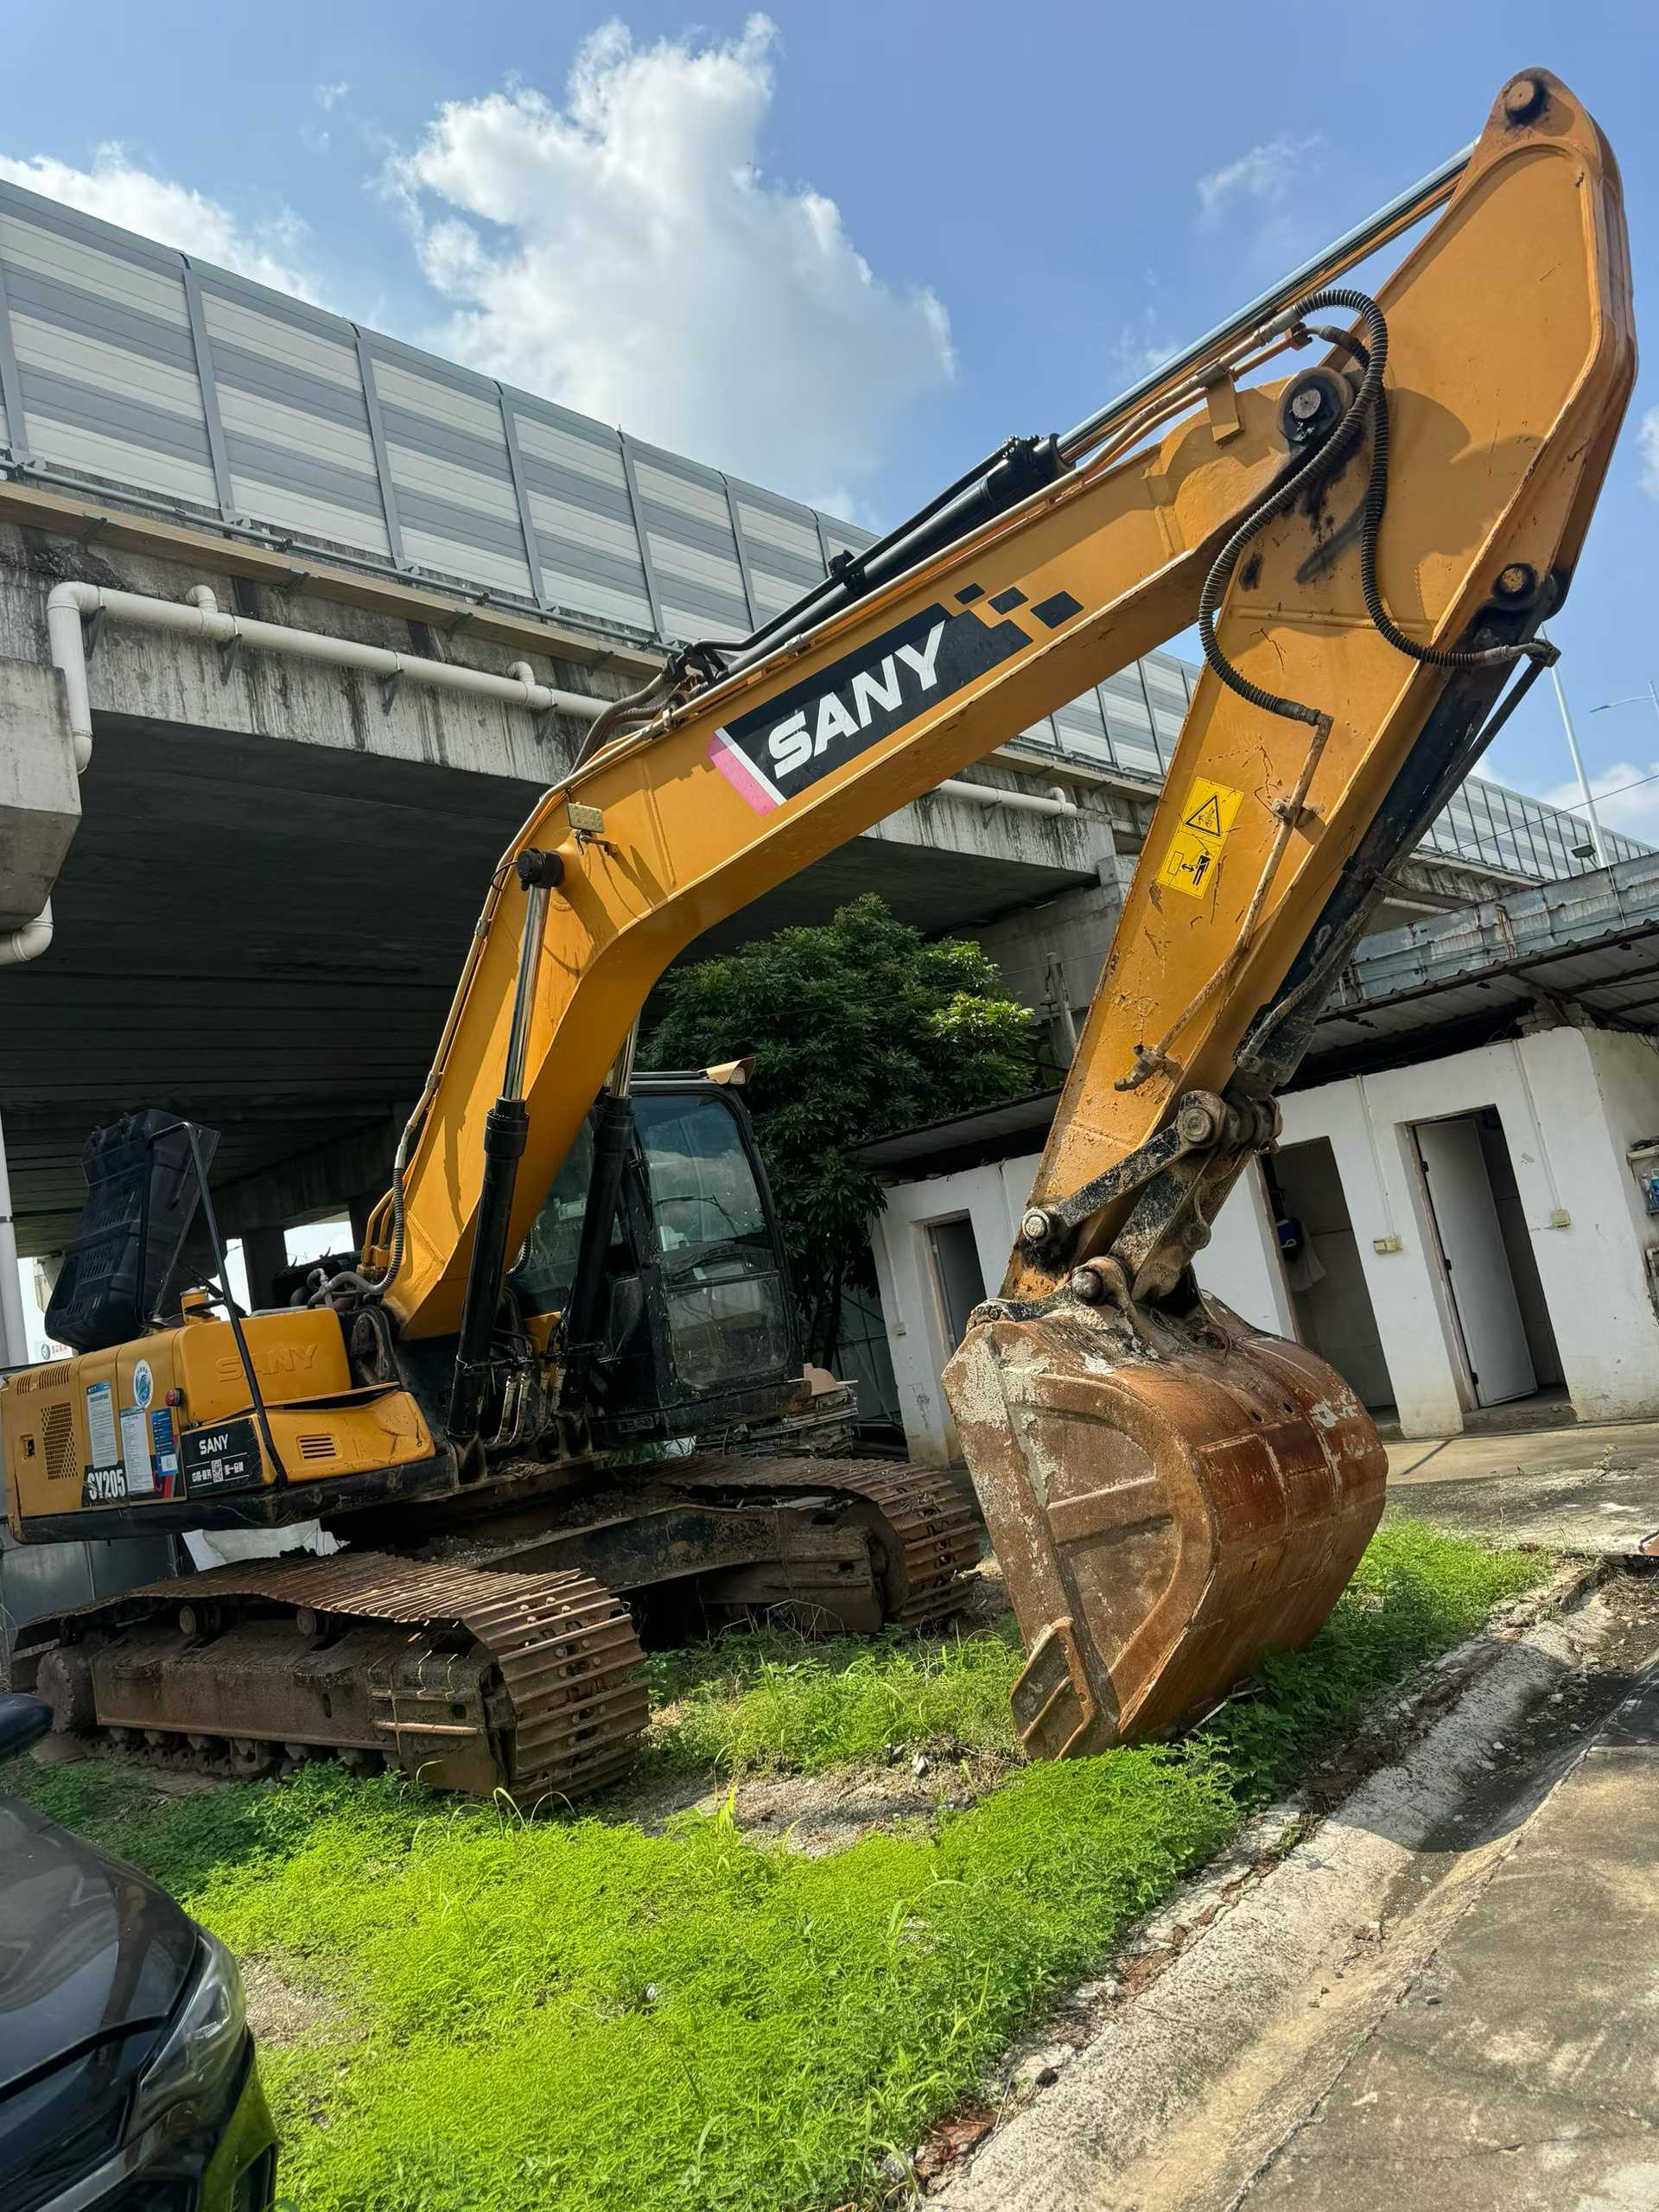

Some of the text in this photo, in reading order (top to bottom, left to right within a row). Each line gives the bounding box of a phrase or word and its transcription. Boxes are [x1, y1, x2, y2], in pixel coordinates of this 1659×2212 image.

[767, 619, 947, 779] SANY
[199, 1433, 228, 1455] SANY
[87, 1469, 126, 1500] SY205
